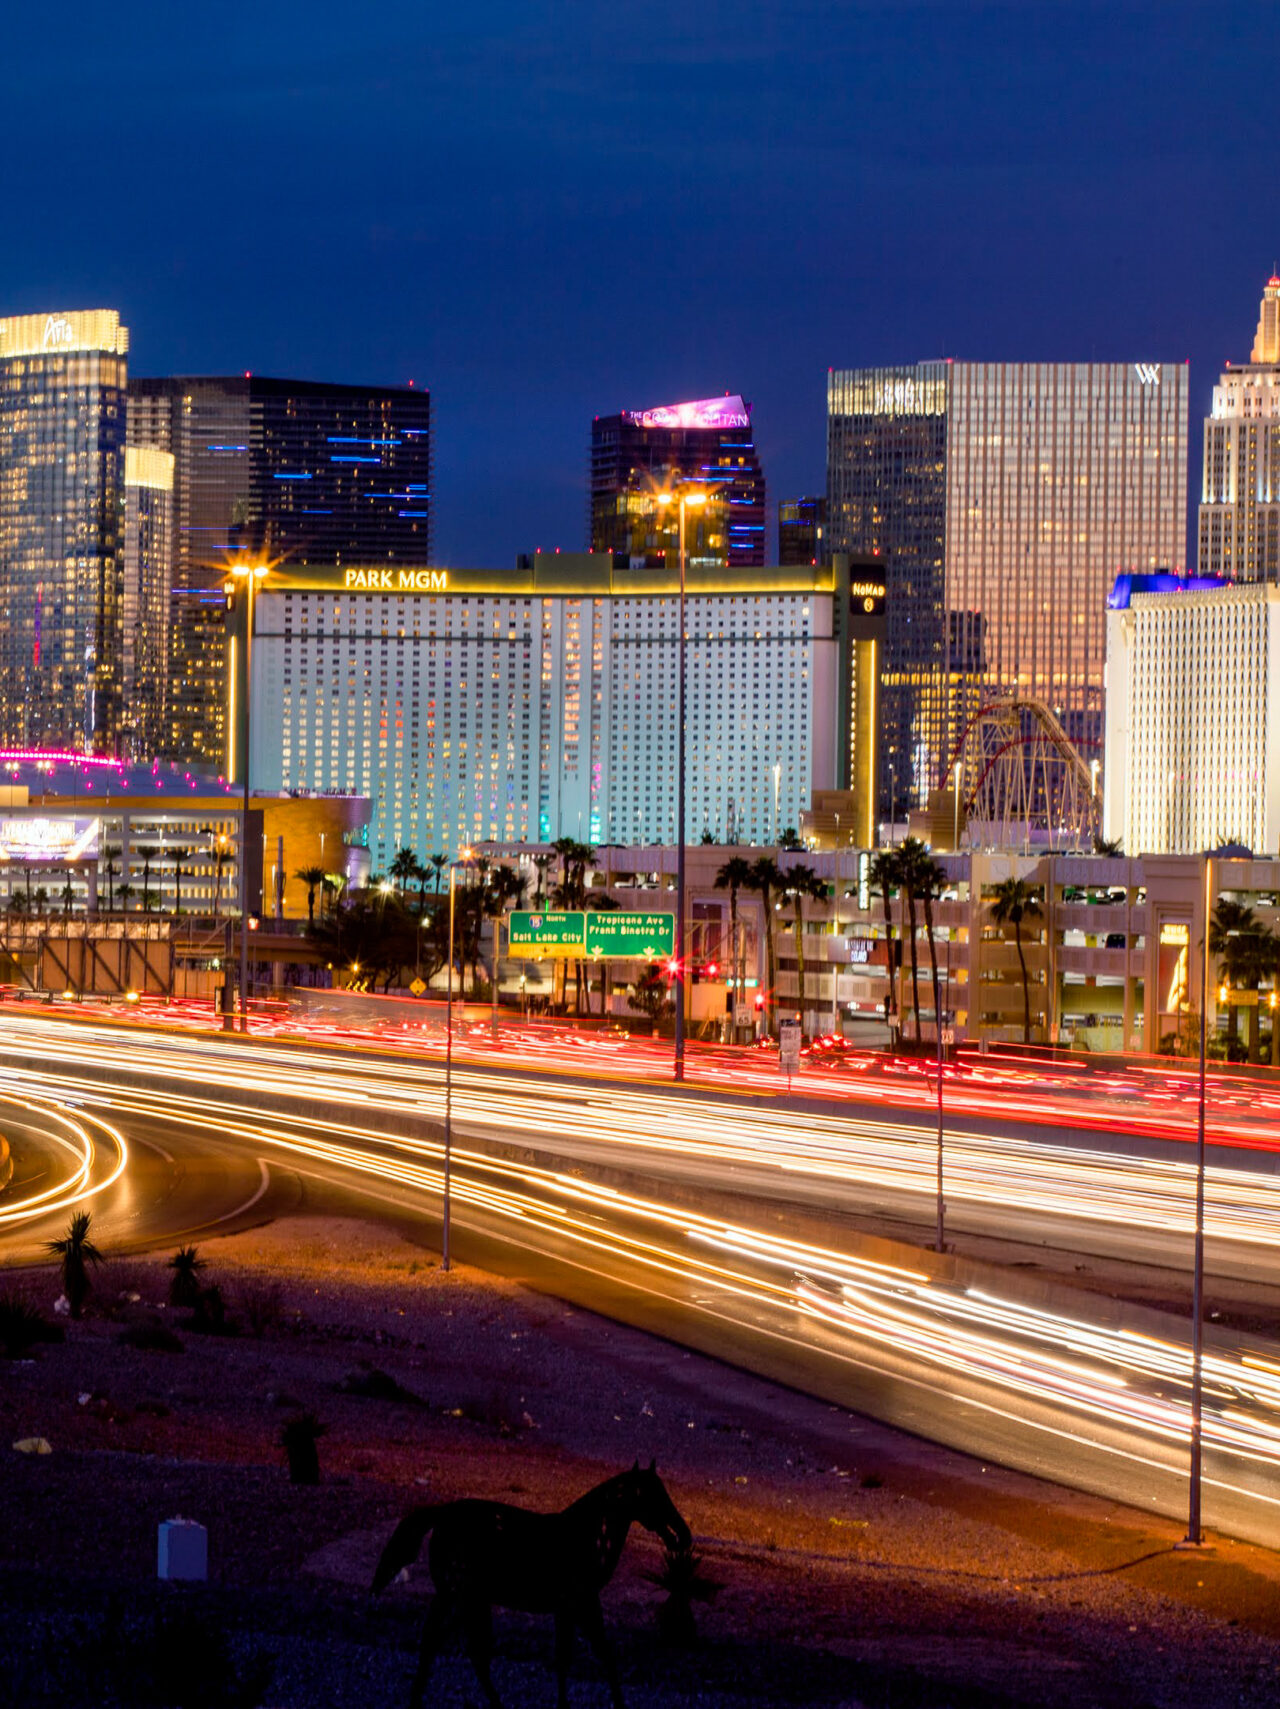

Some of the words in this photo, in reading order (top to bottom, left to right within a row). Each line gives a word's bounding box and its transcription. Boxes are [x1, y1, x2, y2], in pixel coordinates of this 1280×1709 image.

[43, 316, 73, 347] Aria
[630, 411, 642, 419] THE
[345, 568, 393, 588] PARK
[399, 570, 448, 589] MGM
[597, 915, 642, 925] Tropicana
[646, 916, 664, 925] Ave
[589, 925, 616, 935] Frank
[620, 925, 655, 936] Sinatra
[658, 926, 670, 936] Dr
[512, 932, 532, 942] Salt
[535, 932, 558, 942] Lake
[562, 932, 582, 944] City
